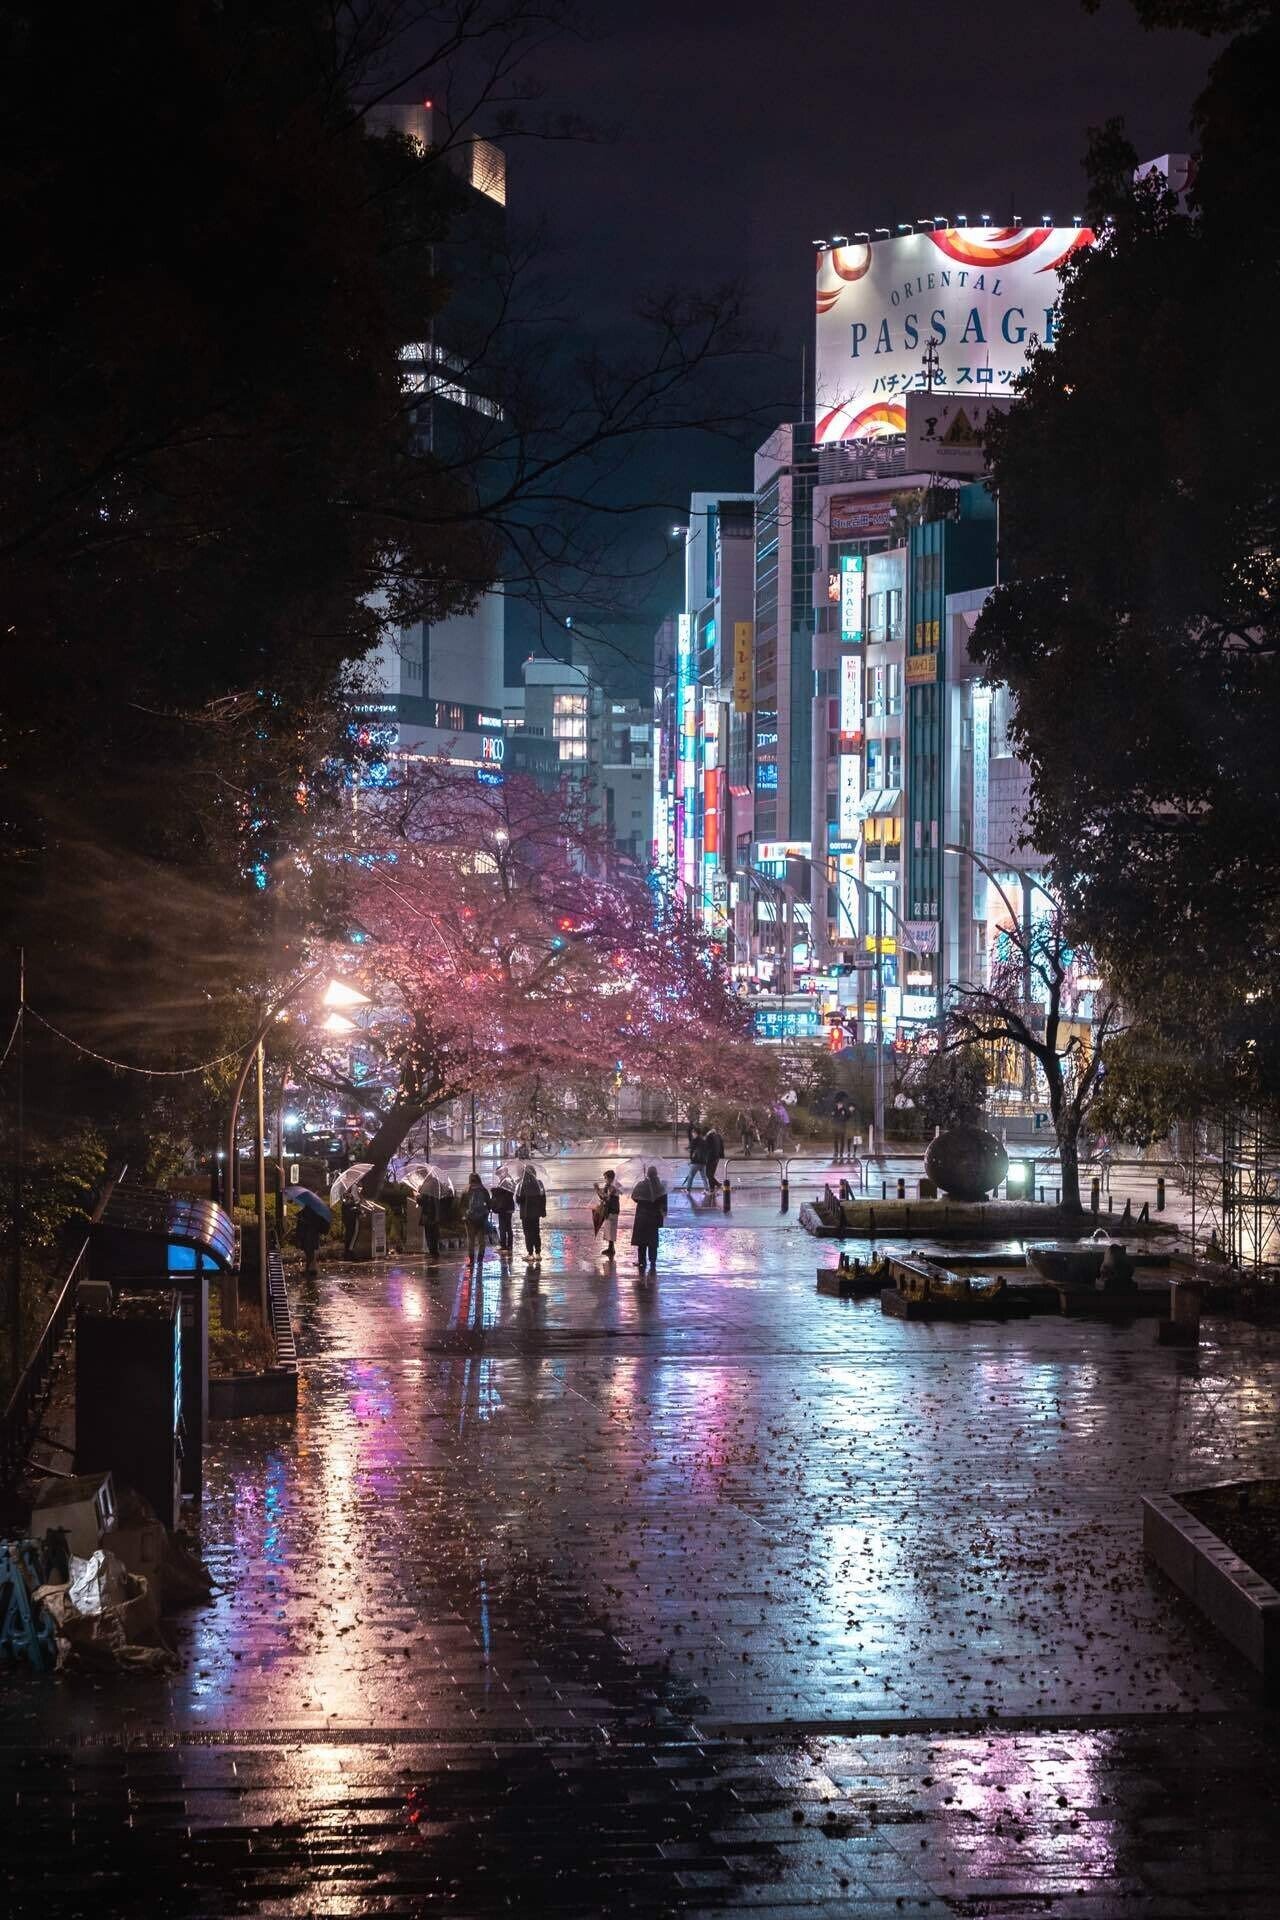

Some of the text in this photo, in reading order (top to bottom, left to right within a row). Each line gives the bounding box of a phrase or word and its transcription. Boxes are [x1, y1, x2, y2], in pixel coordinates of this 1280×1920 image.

[890, 270, 1003, 306] ORIENTAL
[873, 370, 927, 393] パチンコ
[934, 368, 947, 386] &
[846, 577, 854, 627] SPACE
[483, 737, 504, 760] PARCO
[756, 1013, 817, 1025] 上野中央通り
